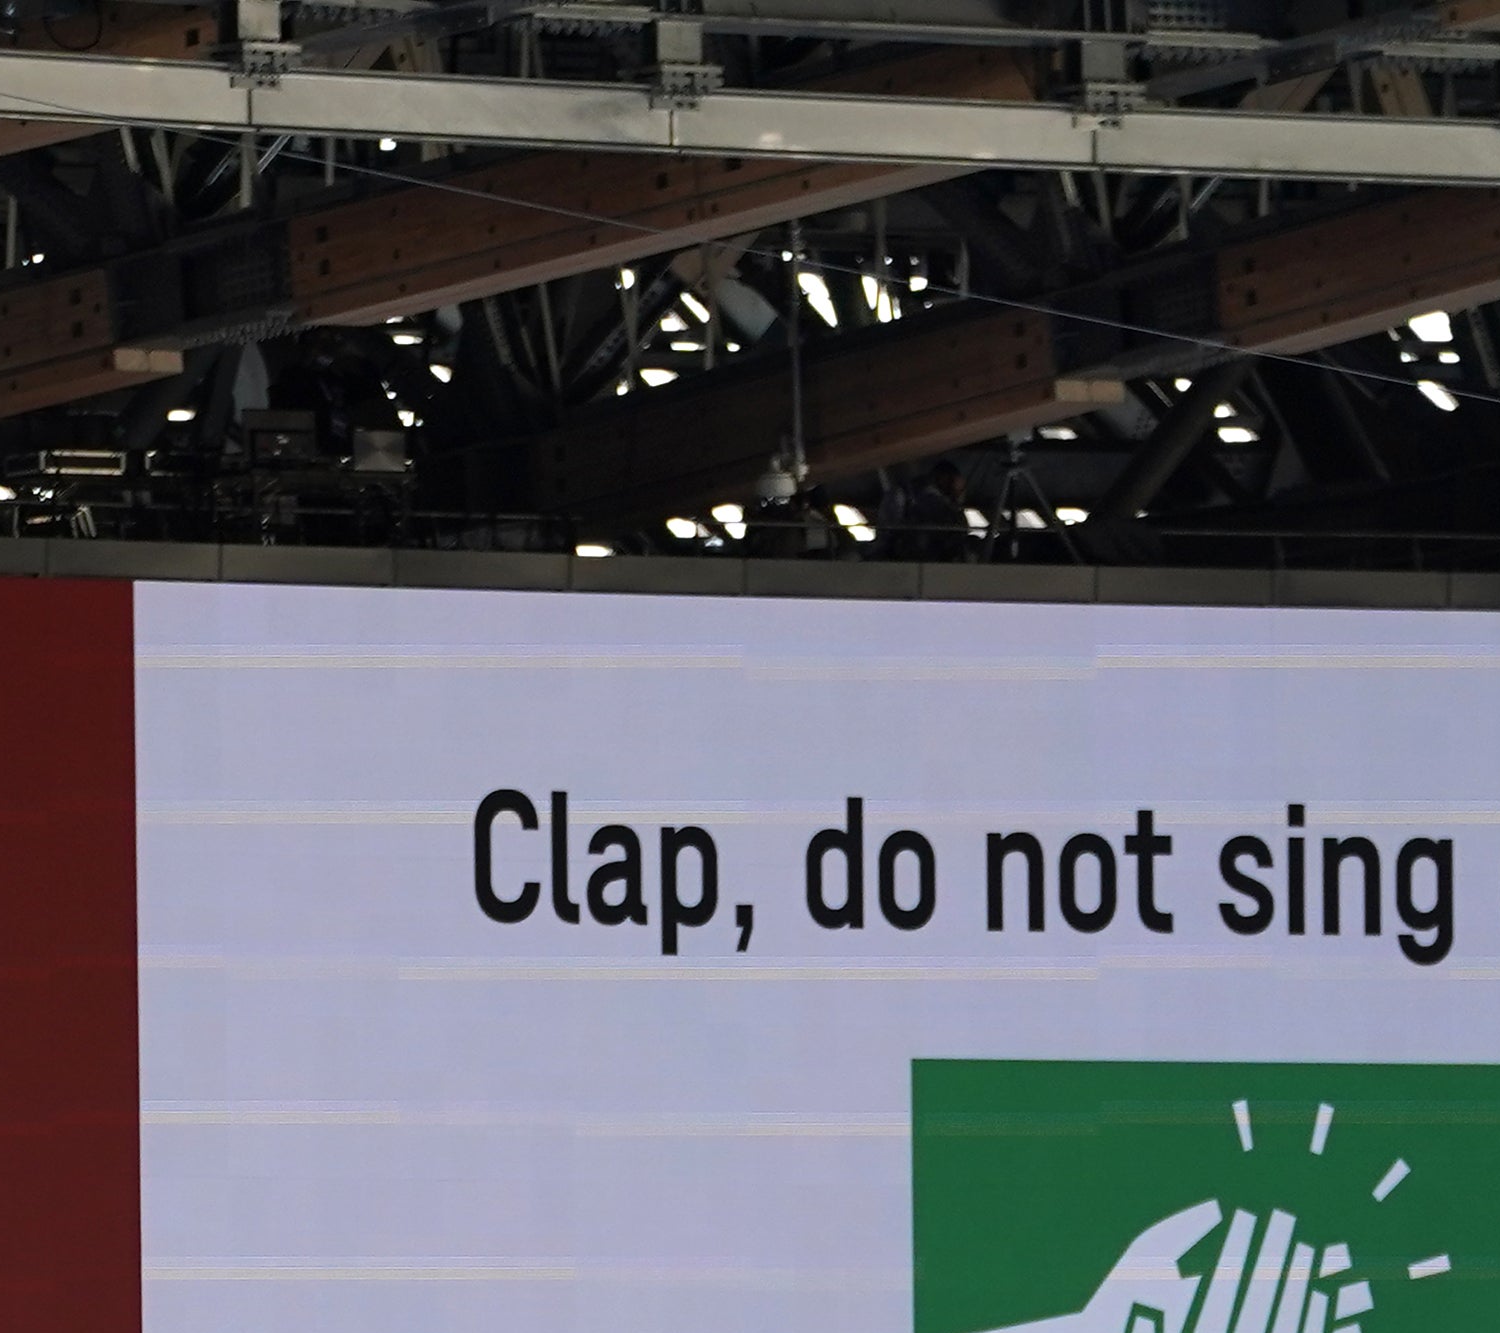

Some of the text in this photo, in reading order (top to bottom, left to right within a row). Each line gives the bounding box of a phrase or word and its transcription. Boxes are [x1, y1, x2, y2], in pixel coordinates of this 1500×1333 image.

[474, 789, 753, 956] Clap,
[806, 797, 936, 931] do
[986, 810, 1173, 934] not
[1219, 804, 1454, 966] sing
